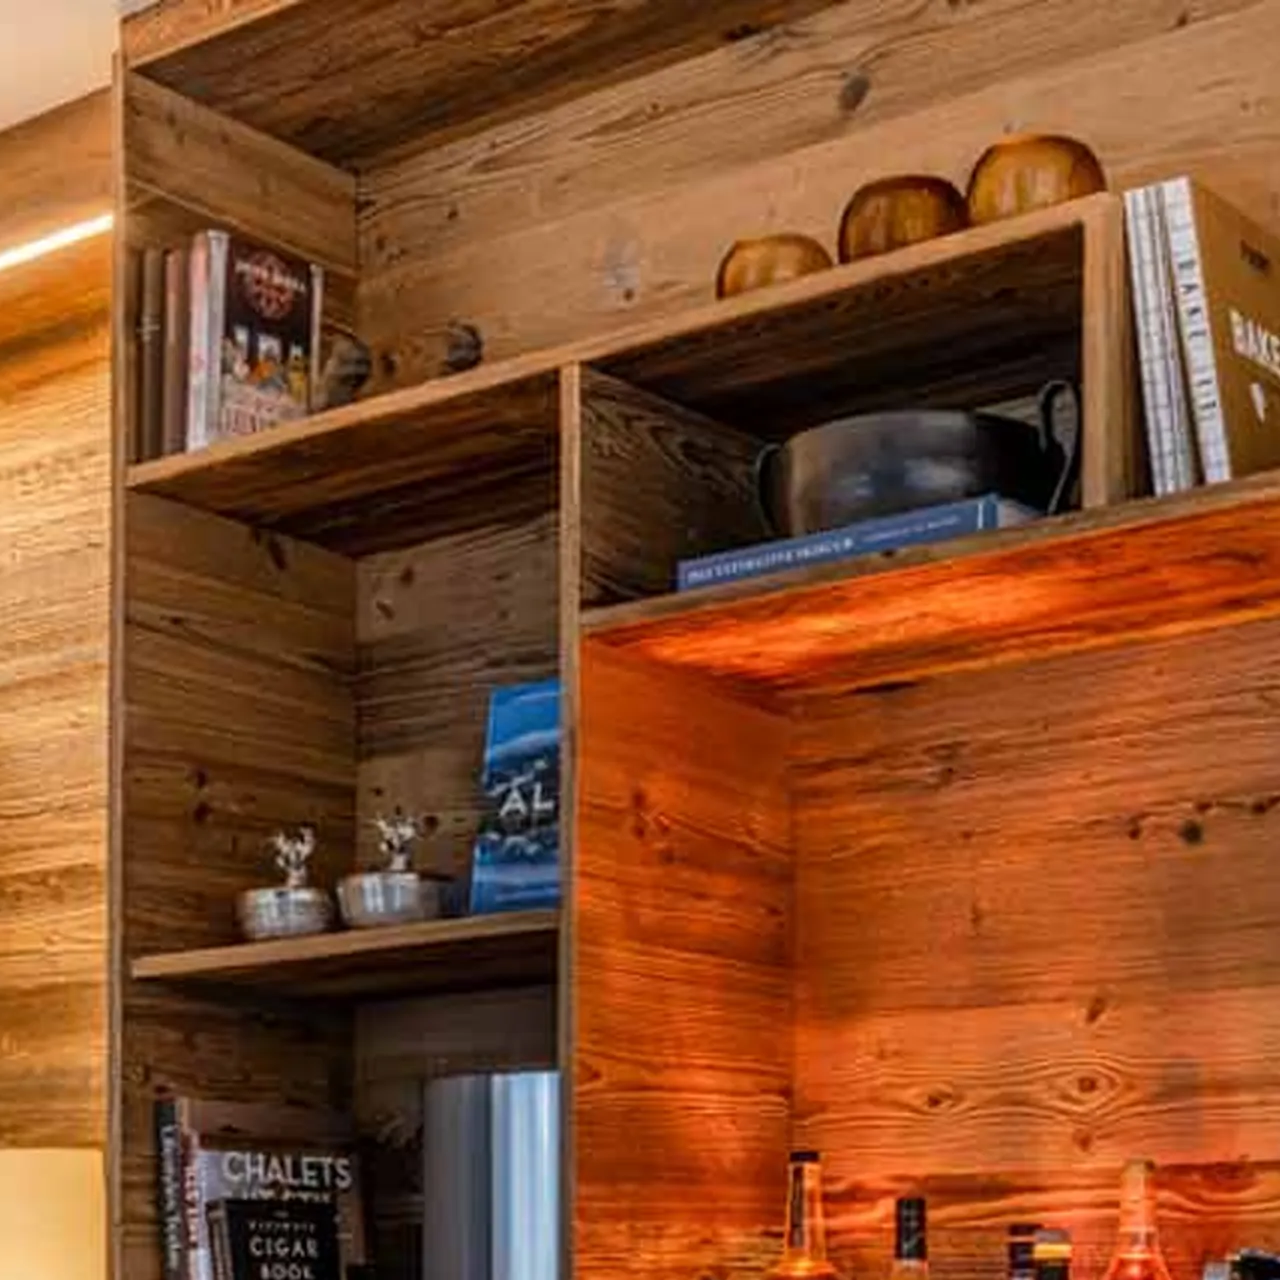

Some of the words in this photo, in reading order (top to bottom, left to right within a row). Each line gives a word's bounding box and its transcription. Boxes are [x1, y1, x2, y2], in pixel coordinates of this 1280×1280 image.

[221, 1150, 353, 1189] CHALETS
[248, 1236, 319, 1259] CIGAR
[259, 1262, 316, 1280] BOOK
